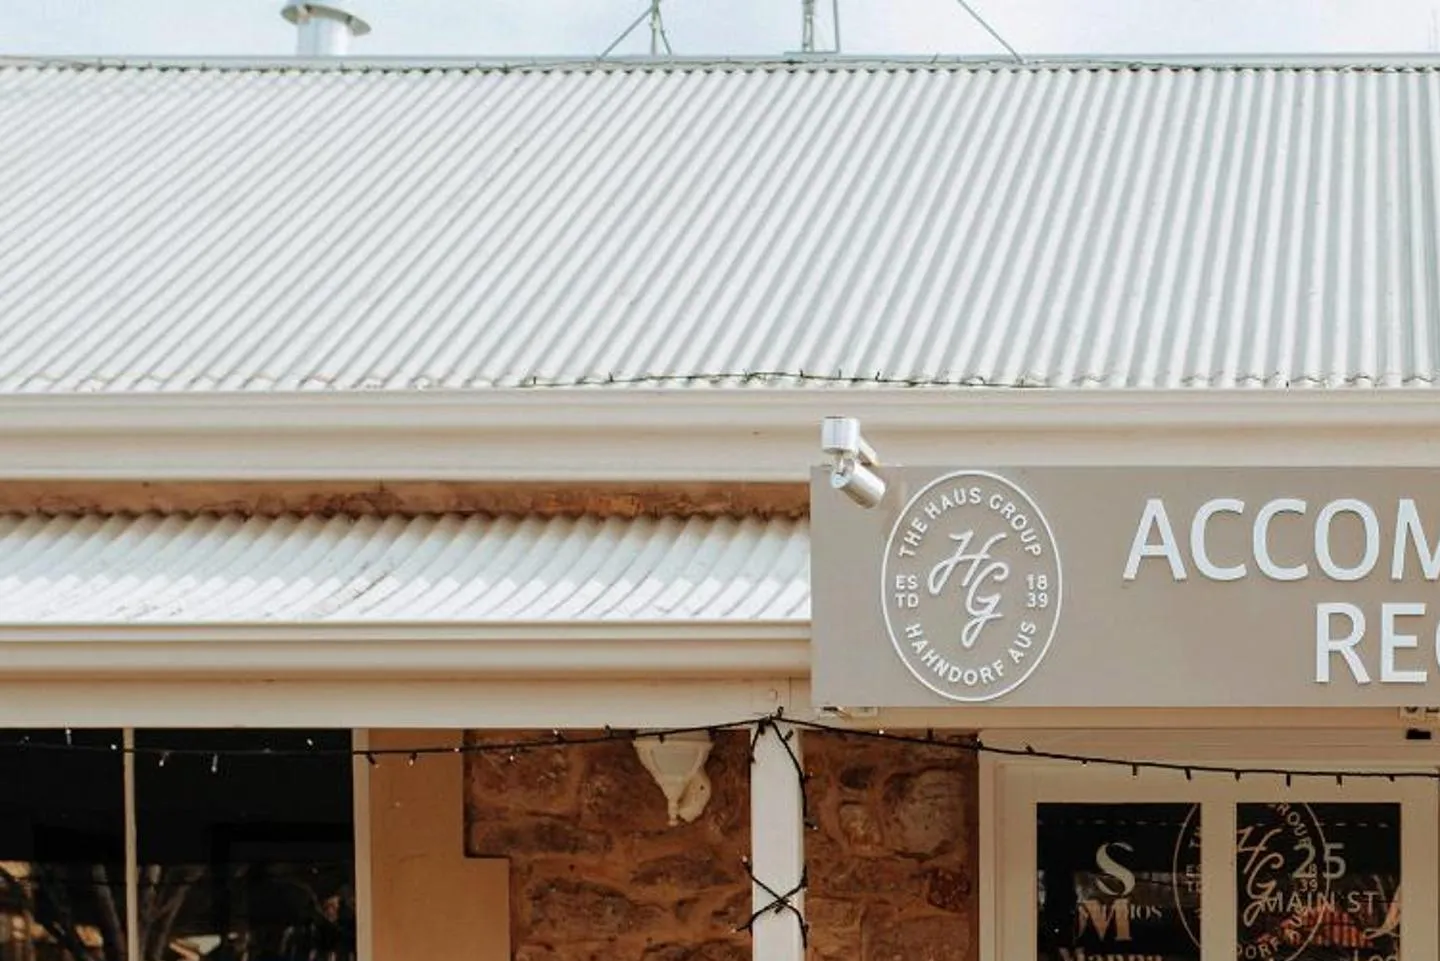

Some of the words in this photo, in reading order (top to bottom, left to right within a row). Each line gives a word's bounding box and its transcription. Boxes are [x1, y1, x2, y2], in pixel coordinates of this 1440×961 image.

[898, 519, 928, 558] THE
[925, 487, 982, 520] HAUS
[990, 494, 1042, 557] GROUP
[895, 575, 918, 590] ES
[1026, 575, 1048, 591] 18
[895, 593, 919, 608] TD
[1026, 593, 1048, 608] 39
[906, 623, 1004, 686] HAHNDORF
[1008, 622, 1037, 664] AUS
[1292, 843, 1346, 879] 25
[1261, 891, 1336, 914] MAIN
[1348, 890, 1379, 915] ST
